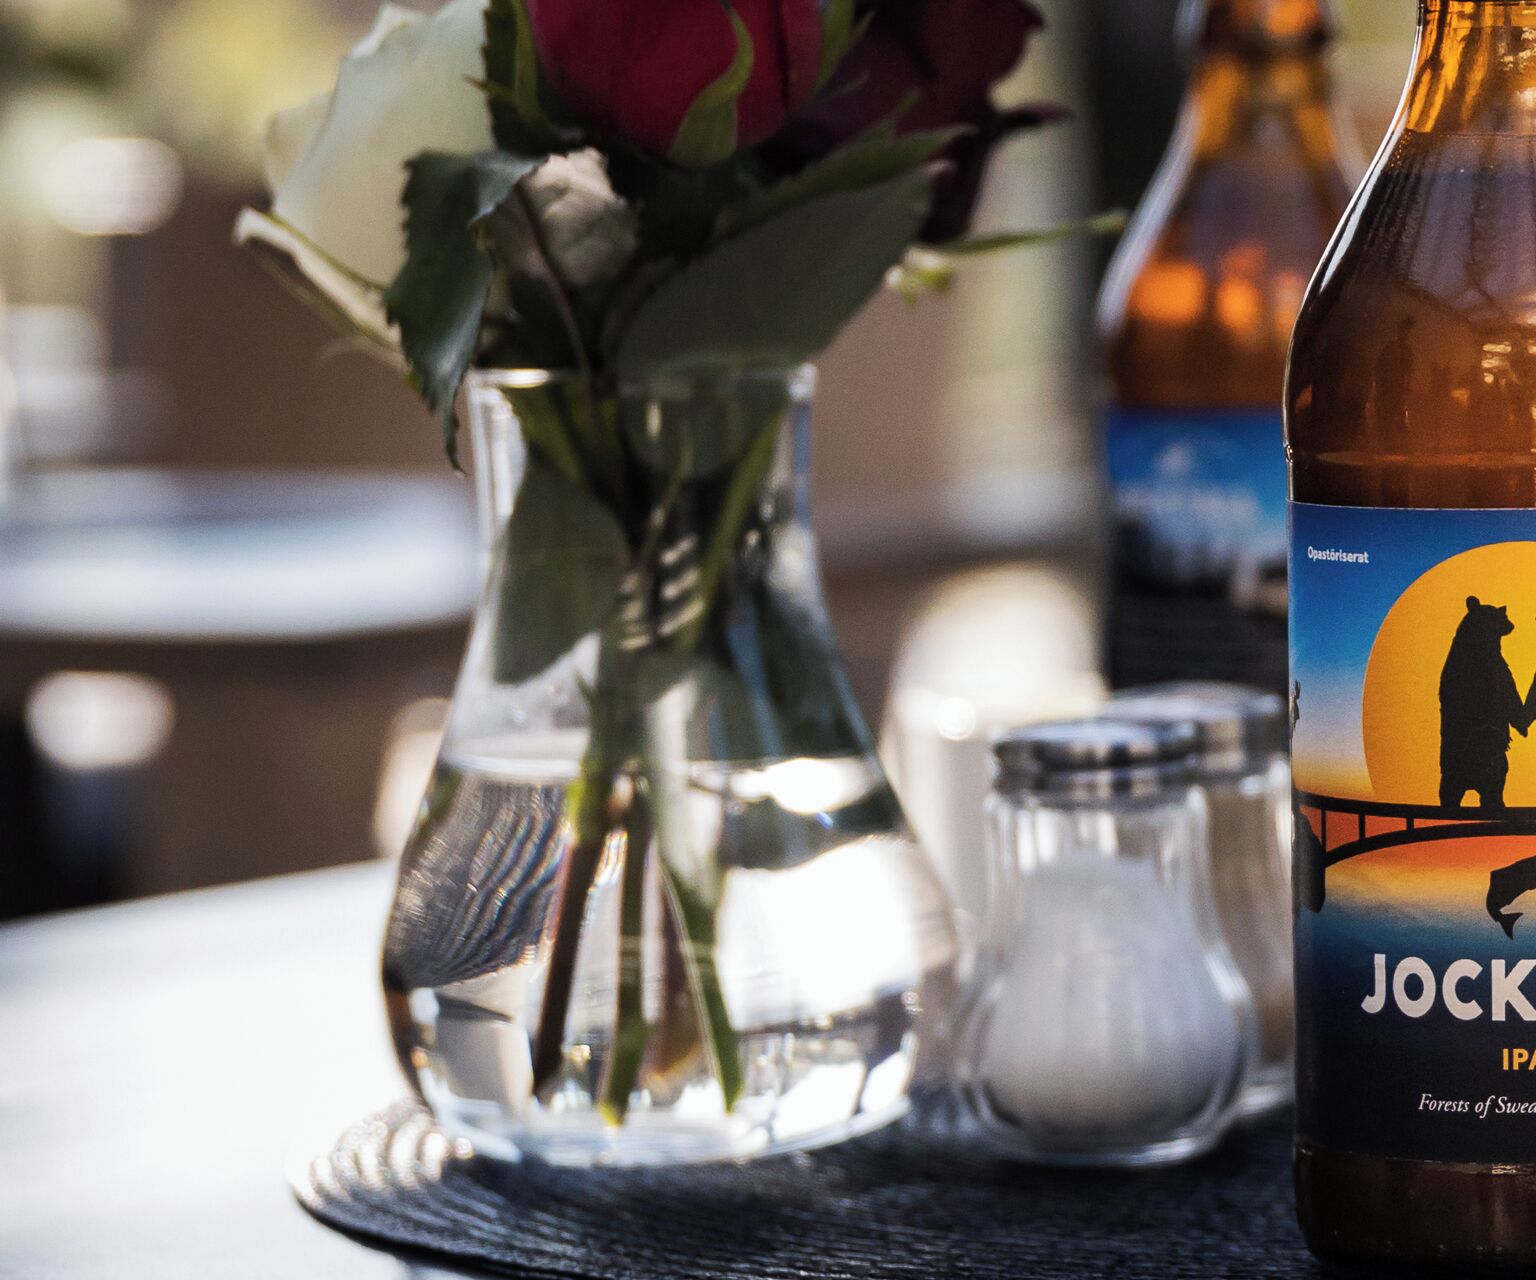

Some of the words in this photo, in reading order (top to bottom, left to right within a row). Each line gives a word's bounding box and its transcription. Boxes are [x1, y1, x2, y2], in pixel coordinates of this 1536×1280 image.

[1307, 545, 1369, 563] Opastöriserat
[1418, 1093, 1470, 1113] Forests
[1475, 1095, 1495, 1119] of
